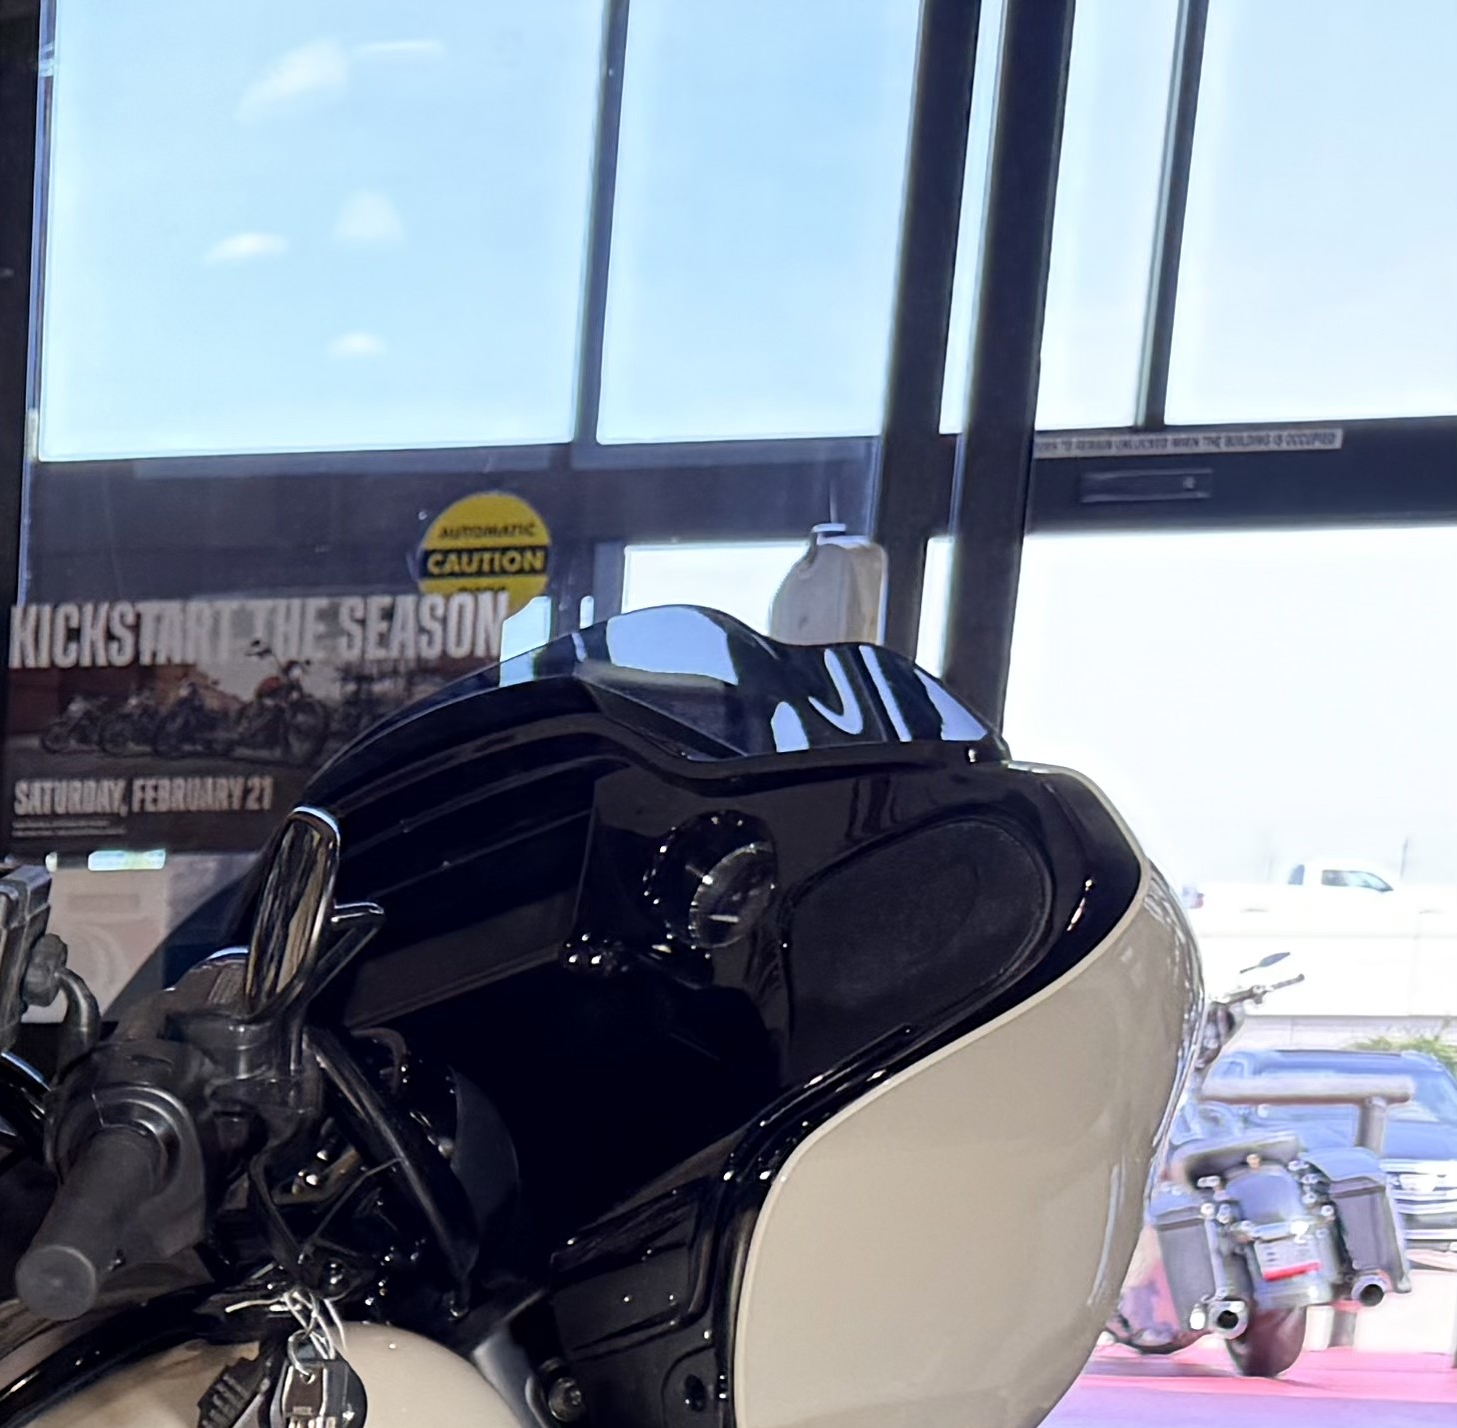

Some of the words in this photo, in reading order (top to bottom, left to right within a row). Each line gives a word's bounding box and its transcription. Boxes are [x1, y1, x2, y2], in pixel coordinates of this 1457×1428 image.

[439, 523, 535, 538] AUTOMATIC
[427, 549, 545, 575] CAUTION
[8, 599, 238, 668] KICKSTART
[244, 597, 331, 662] THE
[338, 590, 510, 661] SEASON
[14, 779, 128, 817] SATURDAY,
[132, 776, 244, 813] FEBRUARY
[245, 776, 274, 811] 21
